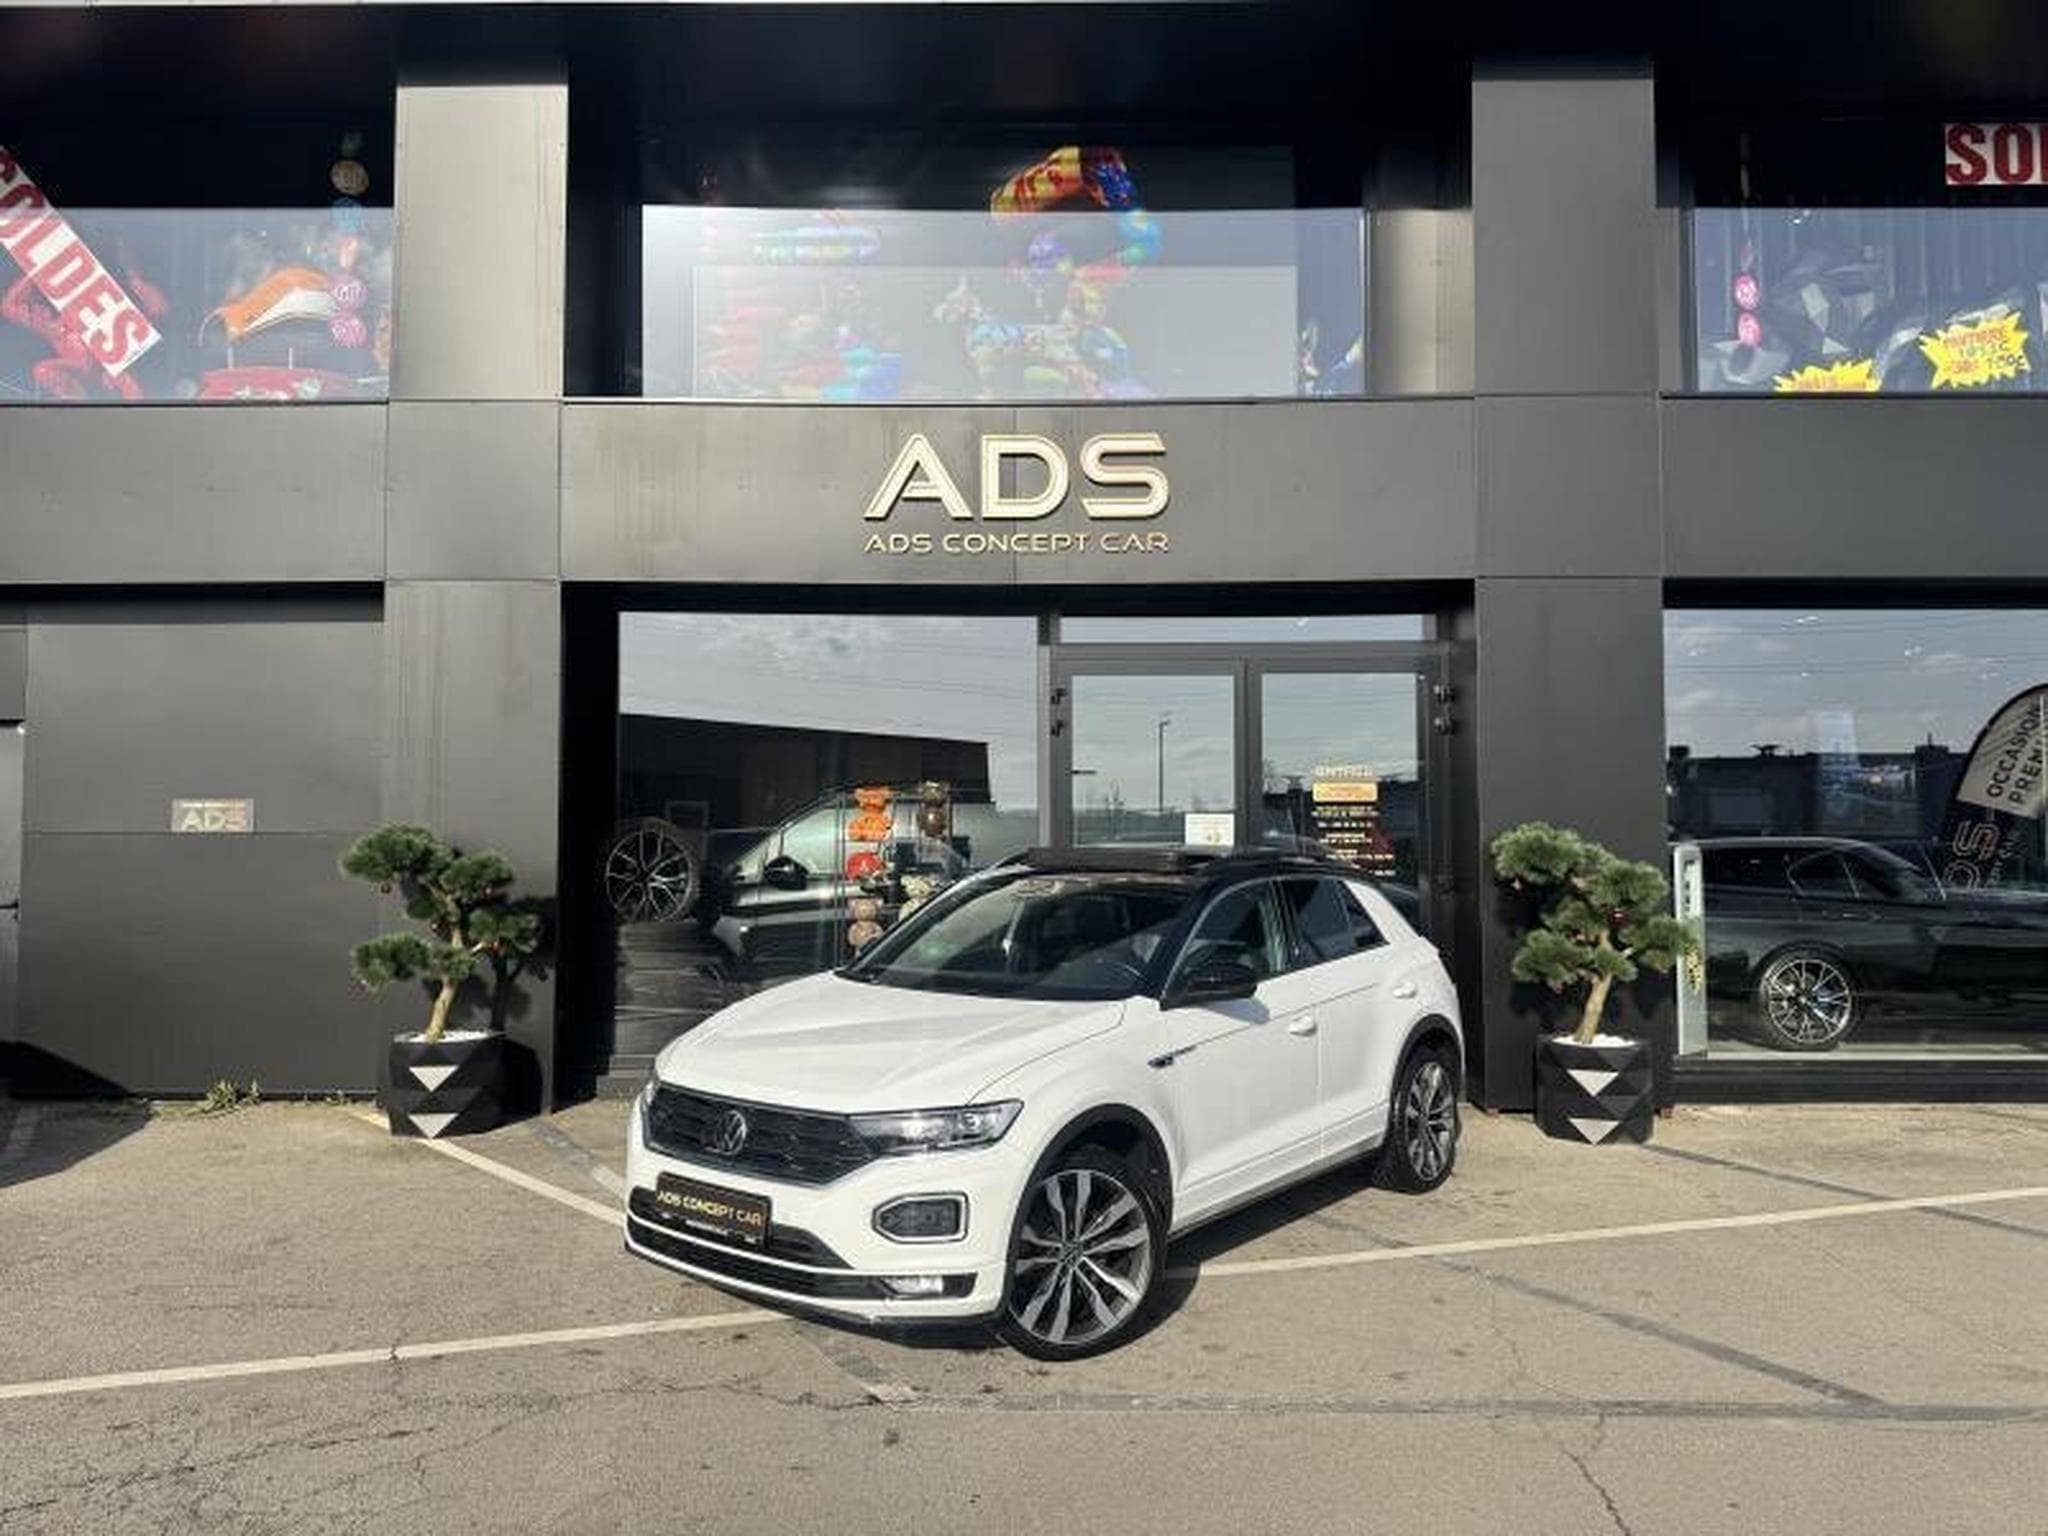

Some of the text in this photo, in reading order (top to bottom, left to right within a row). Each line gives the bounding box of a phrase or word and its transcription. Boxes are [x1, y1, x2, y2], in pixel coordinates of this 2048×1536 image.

[863, 432, 1170, 520] ADS
[864, 531, 1170, 553] ADS CONCEPT CAR
[180, 803, 247, 832] ADS
[657, 1189, 762, 1225] ADS CONCEPT CAR
